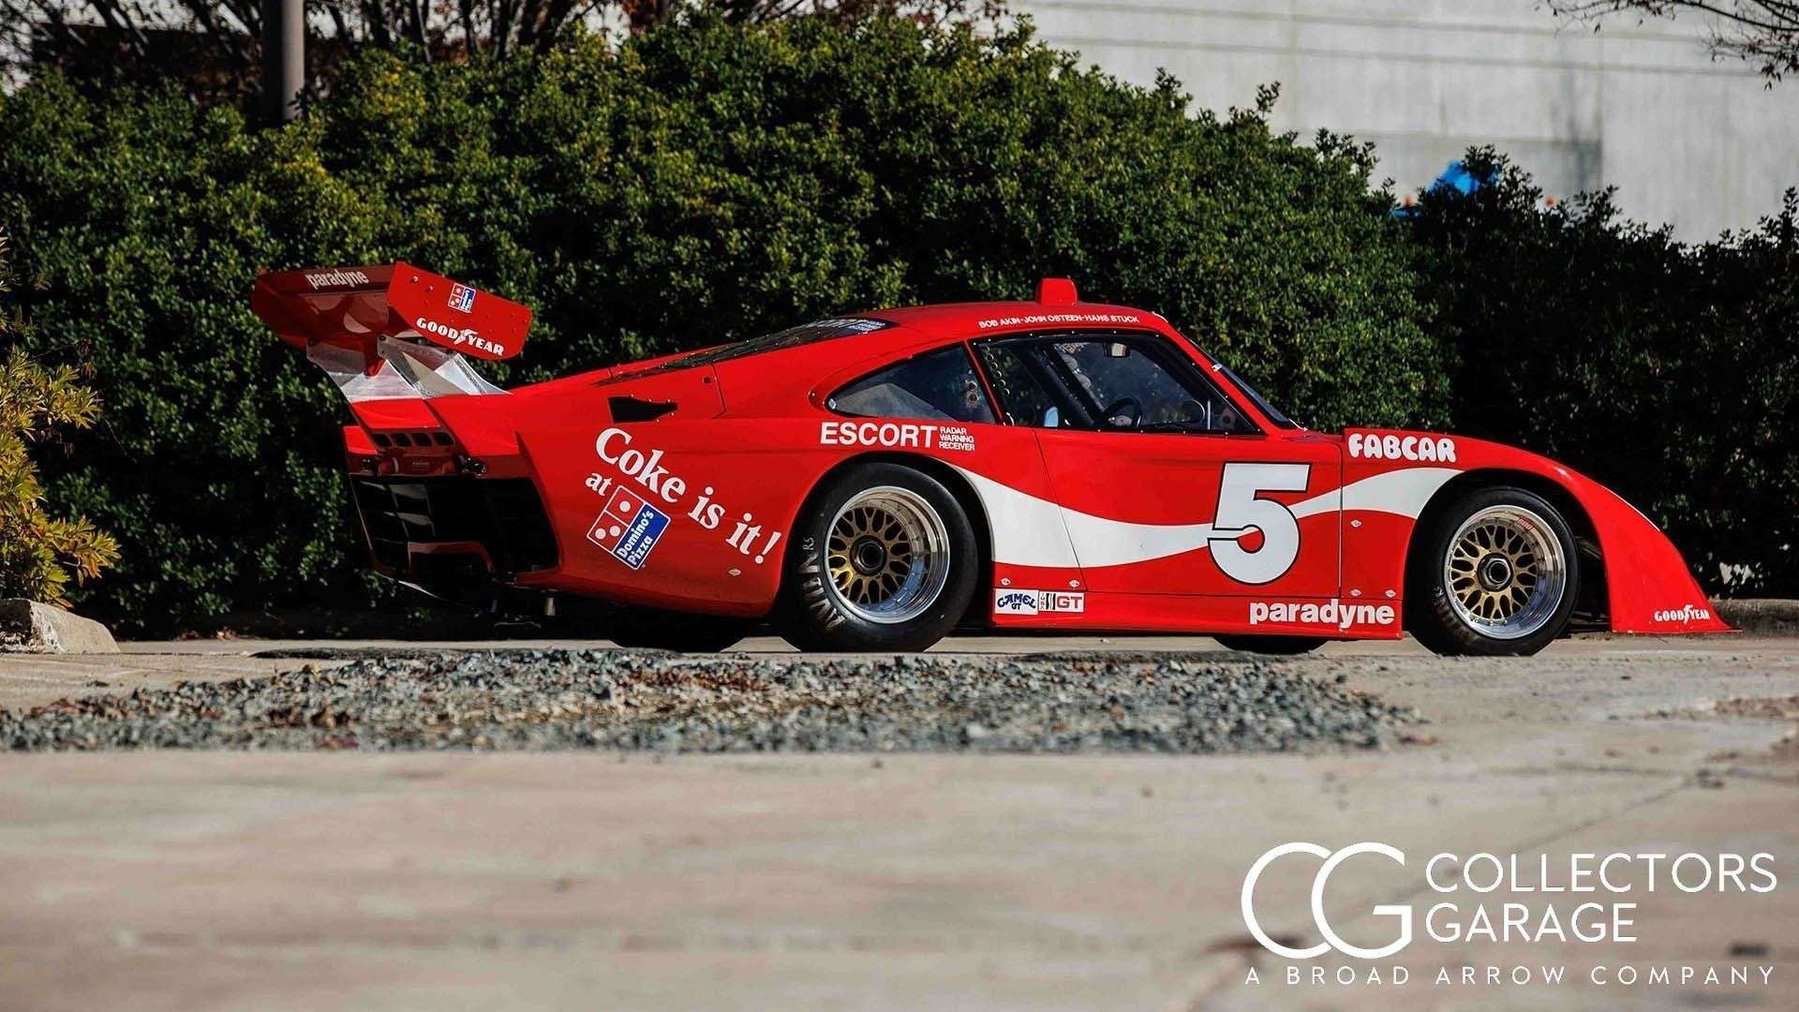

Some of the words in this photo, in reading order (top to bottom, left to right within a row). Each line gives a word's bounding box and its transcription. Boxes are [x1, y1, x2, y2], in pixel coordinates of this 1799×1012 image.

[305, 269, 369, 290] paradyne
[978, 319, 998, 329] BOB
[1110, 314, 1140, 323] STUCK
[820, 422, 938, 448] ESCORT
[940, 426, 967, 435] RADAR
[940, 434, 974, 443] WARNING
[939, 442, 975, 451] RECEIVER
[1348, 433, 1456, 463] FABCAR
[585, 472, 612, 496] at
[595, 427, 686, 503] Coke
[688, 486, 726, 530] is
[616, 509, 655, 558] Domino's
[1207, 461, 1312, 585] 5
[627, 536, 654, 565] Pizza
[997, 593, 1036, 609] CAMEL
[1056, 595, 1083, 609] GT
[1250, 598, 1395, 629] paradyne
